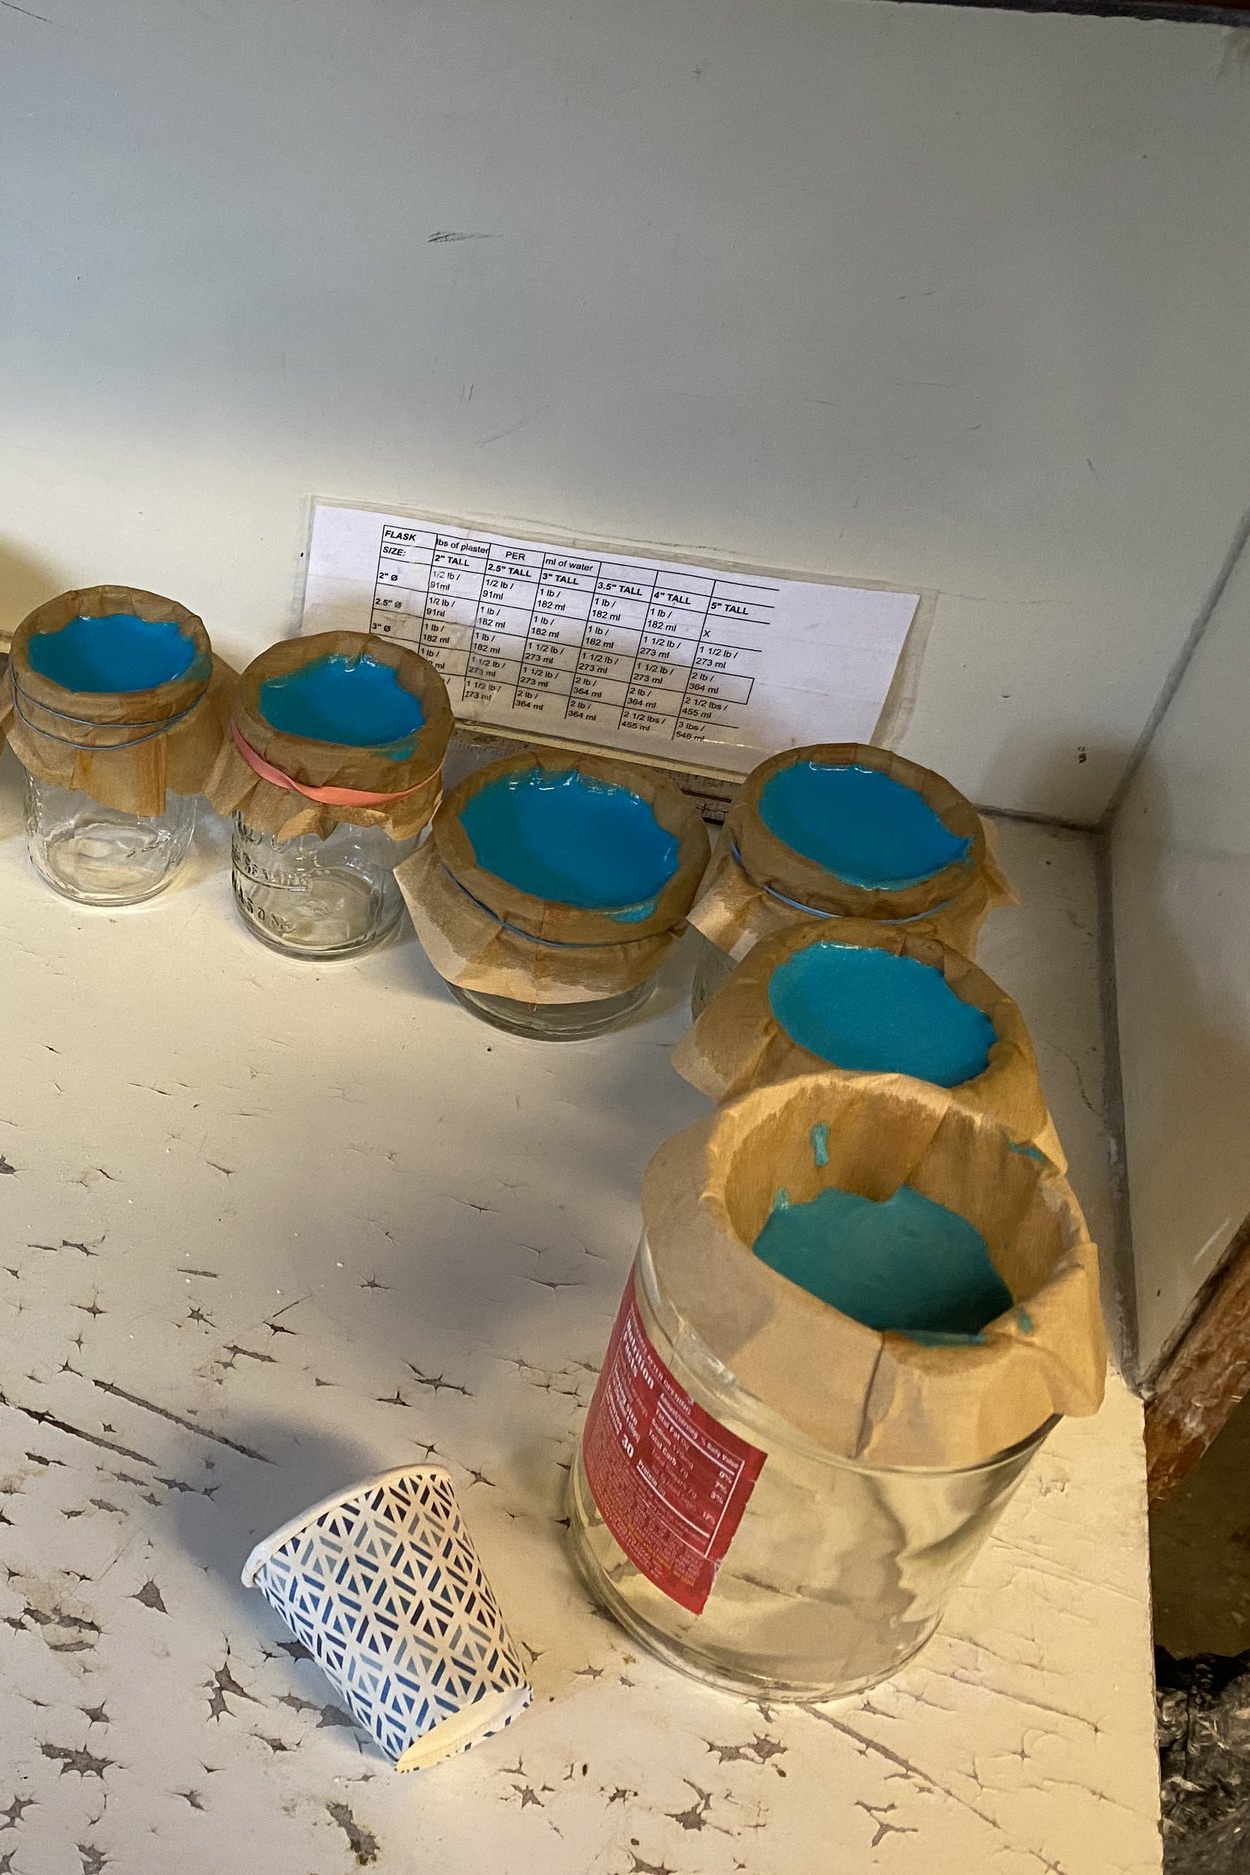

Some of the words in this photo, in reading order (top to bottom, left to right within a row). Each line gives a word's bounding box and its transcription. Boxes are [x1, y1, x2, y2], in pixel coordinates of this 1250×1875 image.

[384, 529, 417, 541] FLASK
[382, 545, 406, 556] SIZE:
[436, 536, 449, 548] lbs
[450, 541, 460, 549] of
[459, 543, 489, 554] plaster
[447, 555, 470, 567] TALL
[504, 550, 526, 561] PER
[544, 557, 557, 566] ml
[557, 559, 568, 567] of
[568, 562, 594, 572] water
[433, 570, 445, 579] 1/2
[446, 571, 455, 580] lb
[508, 566, 532, 578] TALL
[485, 578, 499, 587] 1/2
[499, 580, 508, 589] lb
[554, 574, 579, 585] TALL
[539, 587, 544, 596] 1
[546, 588, 555, 597] lb
[618, 584, 642, 596] TALL
[428, 596, 440, 605] 1/2
[441, 598, 450, 607] lb
[594, 597, 600, 605] 1
[601, 598, 610, 607] lb
[666, 592, 691, 605] TALL
[480, 605, 485, 613] 1
[486, 607, 495, 615] lb
[537, 599, 553, 609] 182
[554, 603, 566, 611] ml
[723, 603, 749, 615] TALL
[591, 609, 608, 619] 182
[608, 613, 621, 621] ml
[650, 607, 655, 616] 1
[656, 608, 666, 618] lb
[478, 616, 494, 627] 182
[494, 621, 506, 629] ml
[533, 615, 538, 623] 1
[540, 616, 549, 625] lb
[647, 619, 664, 630] 182
[664, 624, 677, 632] ml
[424, 622, 429, 630] 1
[430, 623, 439, 632] lb
[531, 626, 547, 636] 182
[588, 625, 593, 633] 1
[594, 626, 603, 635] lb
[422, 633, 438, 643] 182
[438, 636, 450, 644] ml
[475, 631, 479, 639] 1
[481, 632, 490, 641] lb
[643, 635, 648, 643] 1
[651, 637, 665, 647] 1/2
[665, 639, 675, 648] lb
[473, 642, 488, 652] 182
[527, 641, 533, 649] 1
[535, 642, 551, 652] 1/2
[549, 644, 559, 654] lb
[585, 636, 602, 646] 182
[602, 641, 614, 649] ml
[582, 651, 587, 660] 1
[589, 653, 603, 663] 1/2
[603, 655, 613, 664] lb
[638, 646, 656, 657] 273
[657, 651, 670, 659] ml
[699, 645, 704, 653] 1
[707, 647, 722, 656] 1/2
[722, 649, 732, 658] lb
[524, 652, 541, 662] 273
[542, 656, 554, 664] ml
[695, 656, 713, 667] 273
[714, 661, 726, 669] ml
[578, 662, 597, 672] 273
[596, 664, 608, 674] ml
[636, 661, 642, 669] 1
[645, 663, 658, 673] 1/2
[659, 664, 669, 674] lb
[632, 672, 650, 682] 273
[691, 671, 698, 679] 2
[698, 672, 708, 681] lb
[688, 682, 705, 692] 364
[707, 686, 719, 694] ml
